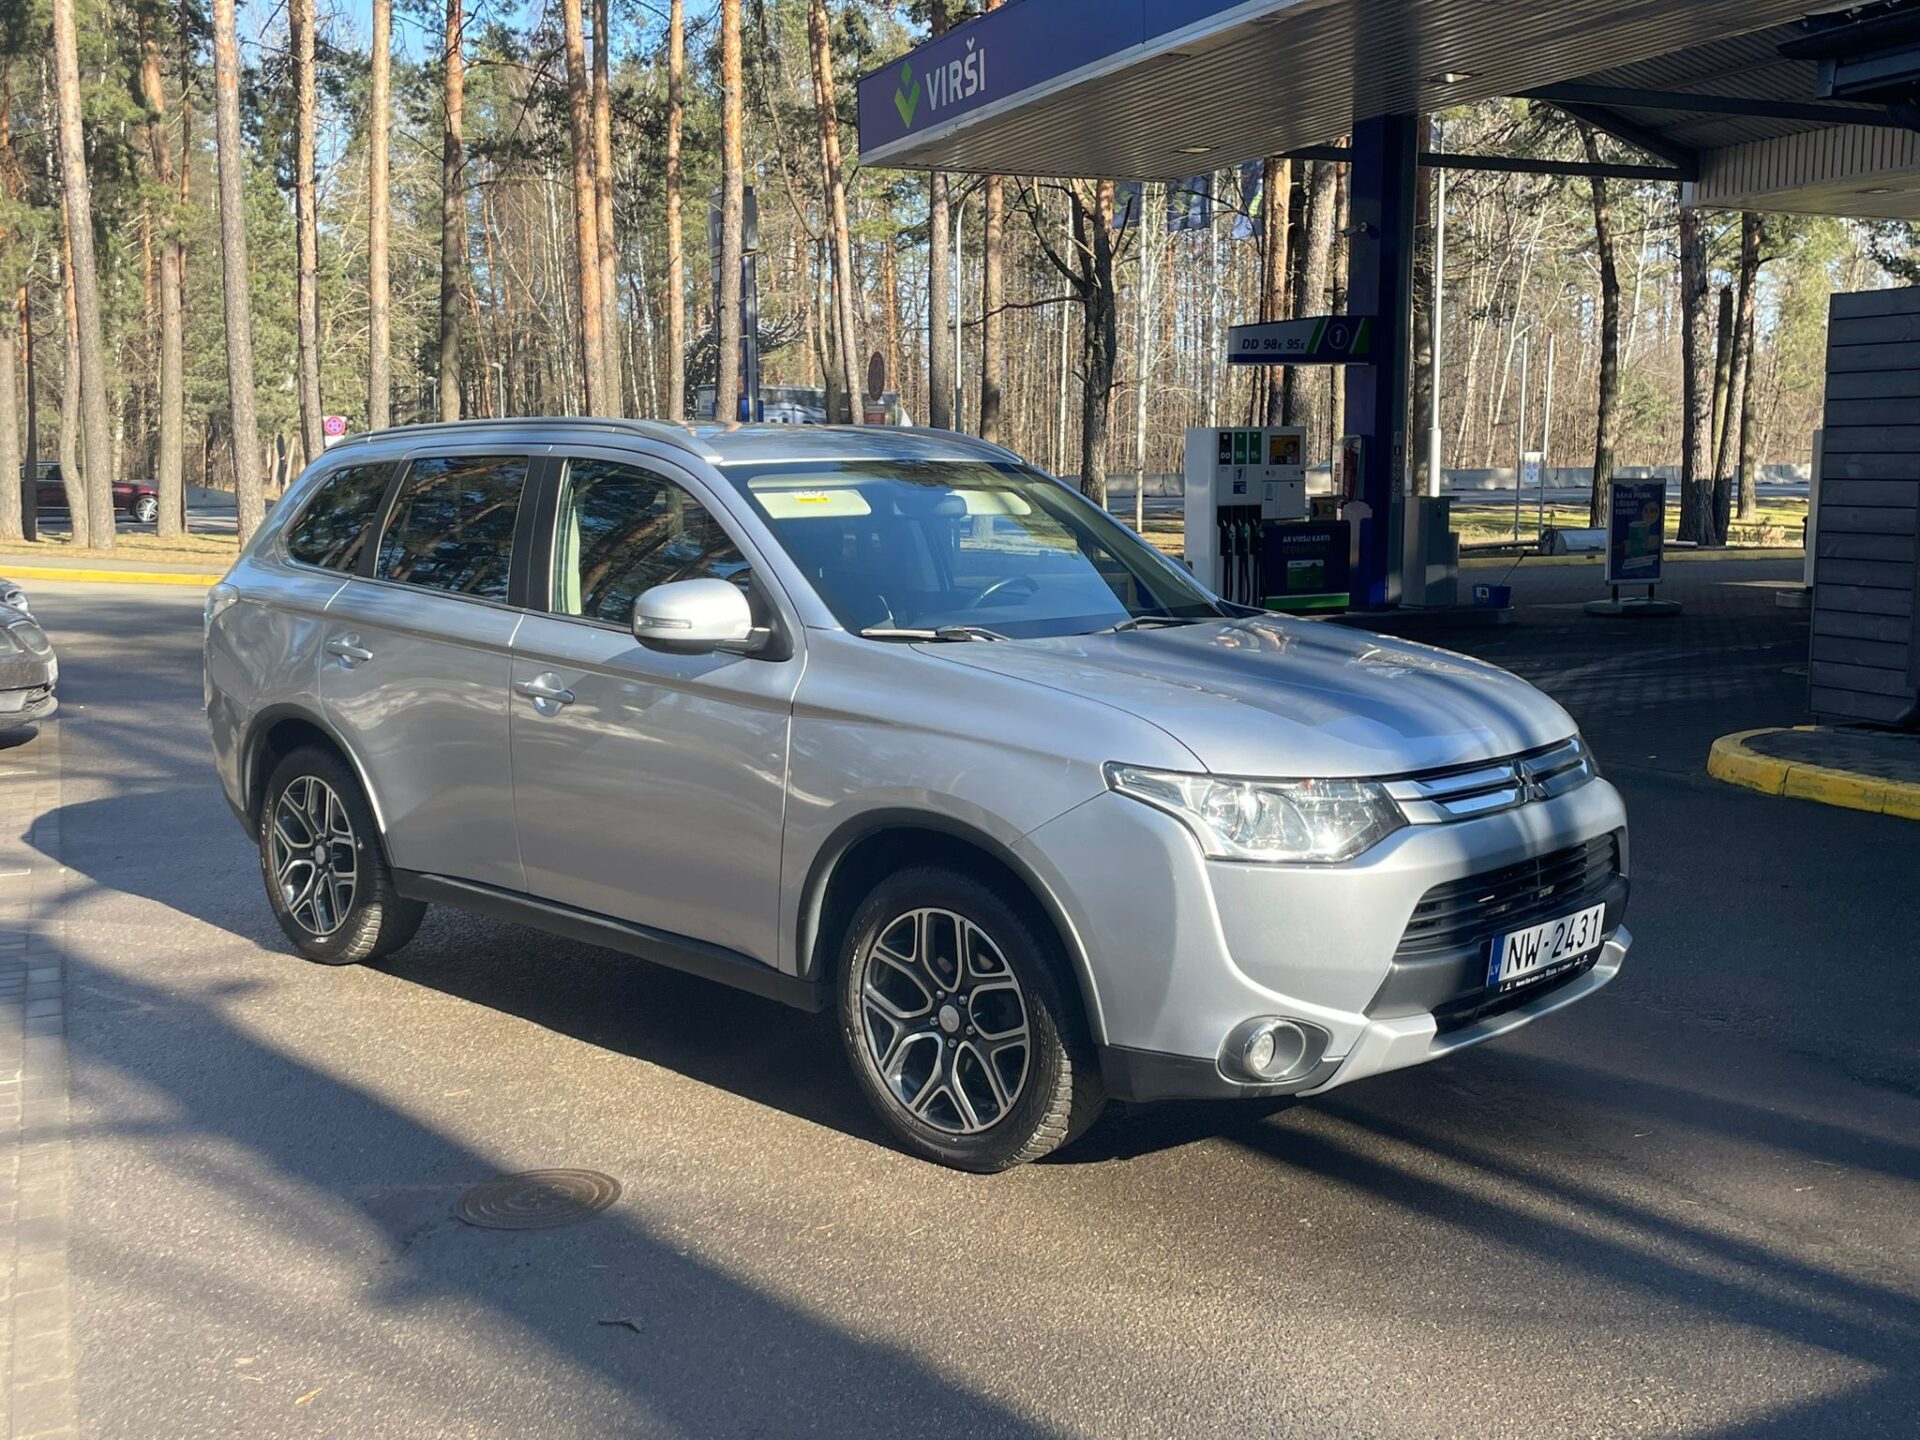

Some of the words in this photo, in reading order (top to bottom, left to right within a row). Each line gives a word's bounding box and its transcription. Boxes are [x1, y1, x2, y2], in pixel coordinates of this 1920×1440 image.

[925, 36, 985, 112] VIRŠI
[1335, 329, 1342, 343] 1
[1242, 338, 1260, 350] DD
[1220, 451, 1231, 460] DD
[1237, 468, 1243, 479] 1
[1506, 909, 1600, 974] NW-2431
[1490, 963, 1500, 976] LV
